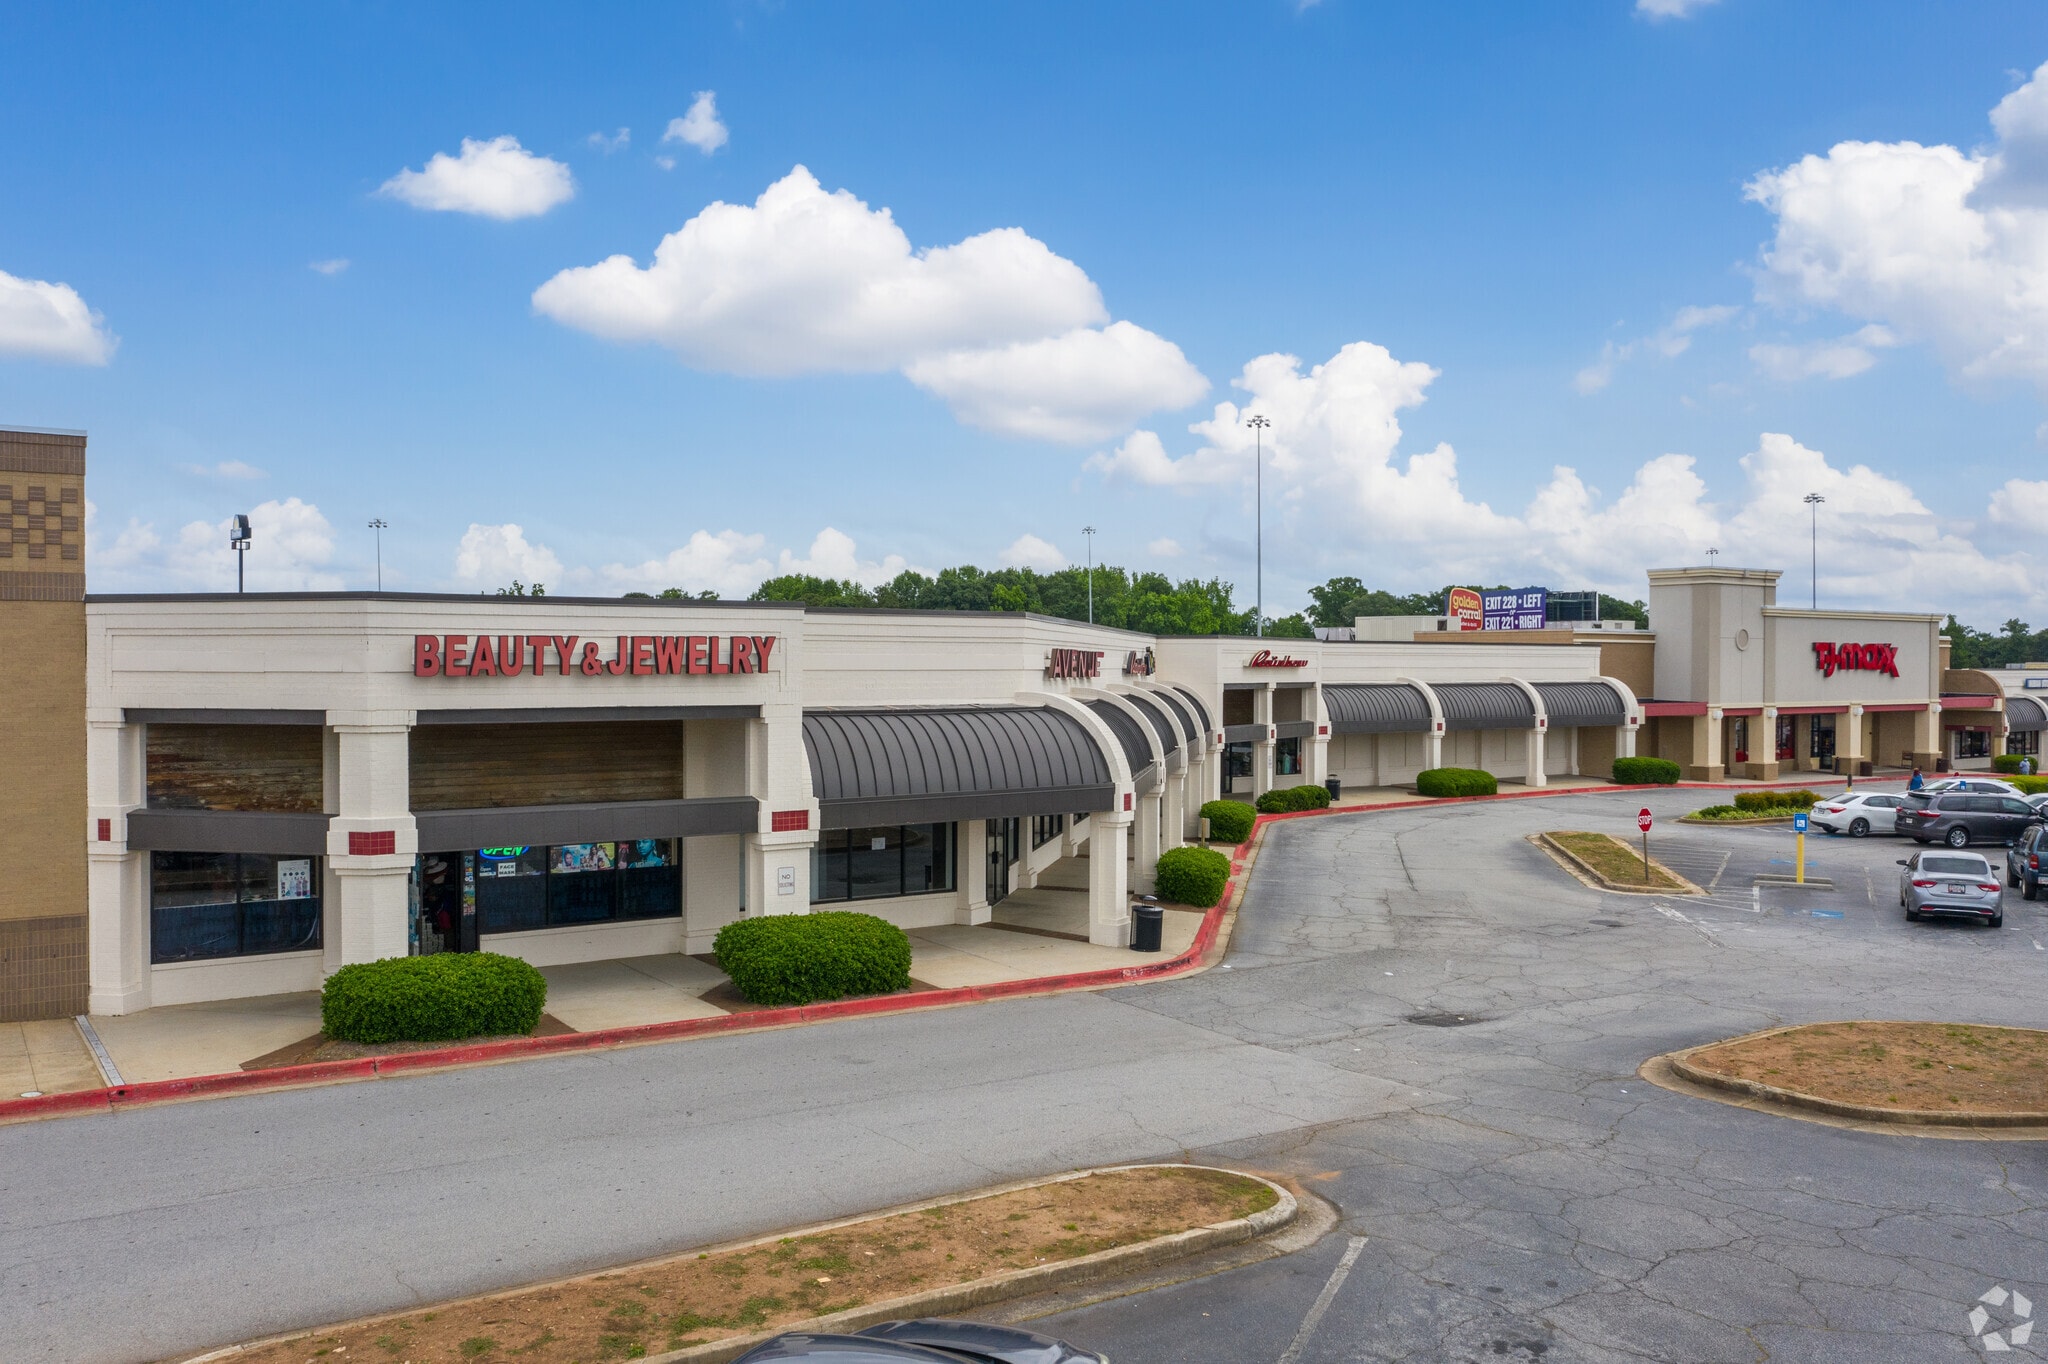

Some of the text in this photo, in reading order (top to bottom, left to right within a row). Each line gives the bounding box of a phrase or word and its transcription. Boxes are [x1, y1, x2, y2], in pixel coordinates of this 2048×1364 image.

[1453, 595, 1479, 609] golden
[1485, 593, 1542, 610] EXIT 228 LEFT
[1457, 608, 1481, 620] corral
[1485, 616, 1501, 630] EXIT
[1501, 616, 1514, 630] 221
[1519, 615, 1542, 629] RIGHT
[1638, 815, 1652, 825] STOP
